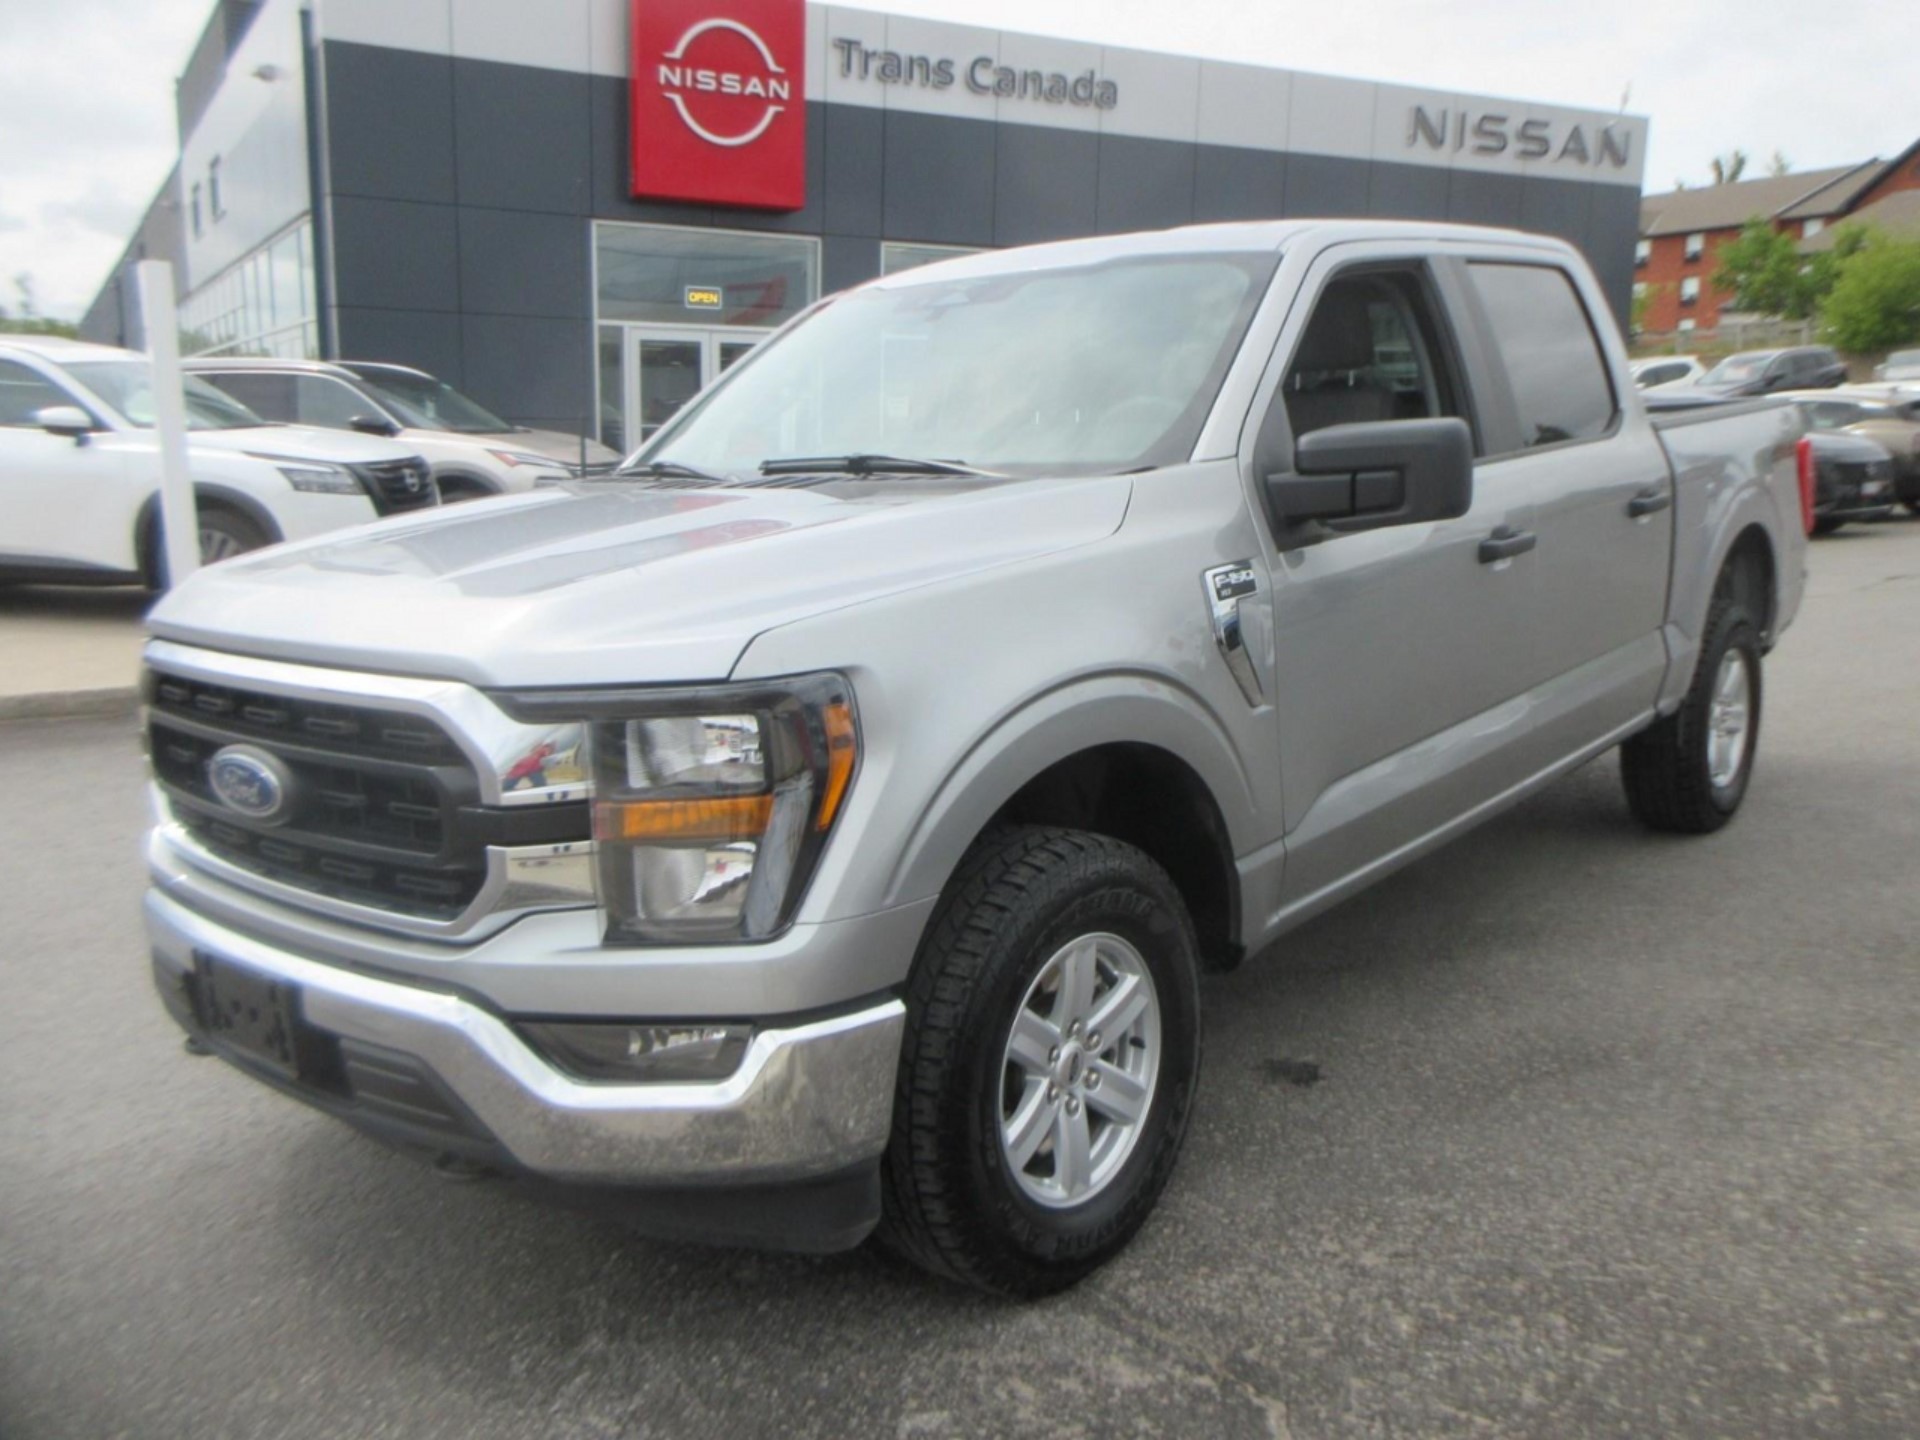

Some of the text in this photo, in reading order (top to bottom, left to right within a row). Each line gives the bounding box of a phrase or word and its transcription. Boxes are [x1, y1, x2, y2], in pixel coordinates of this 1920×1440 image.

[658, 64, 789, 100] NISSAN
[833, 37, 1118, 108] Trans Canada
[1406, 105, 1630, 169] NISSAN
[688, 291, 719, 304] OPEN
